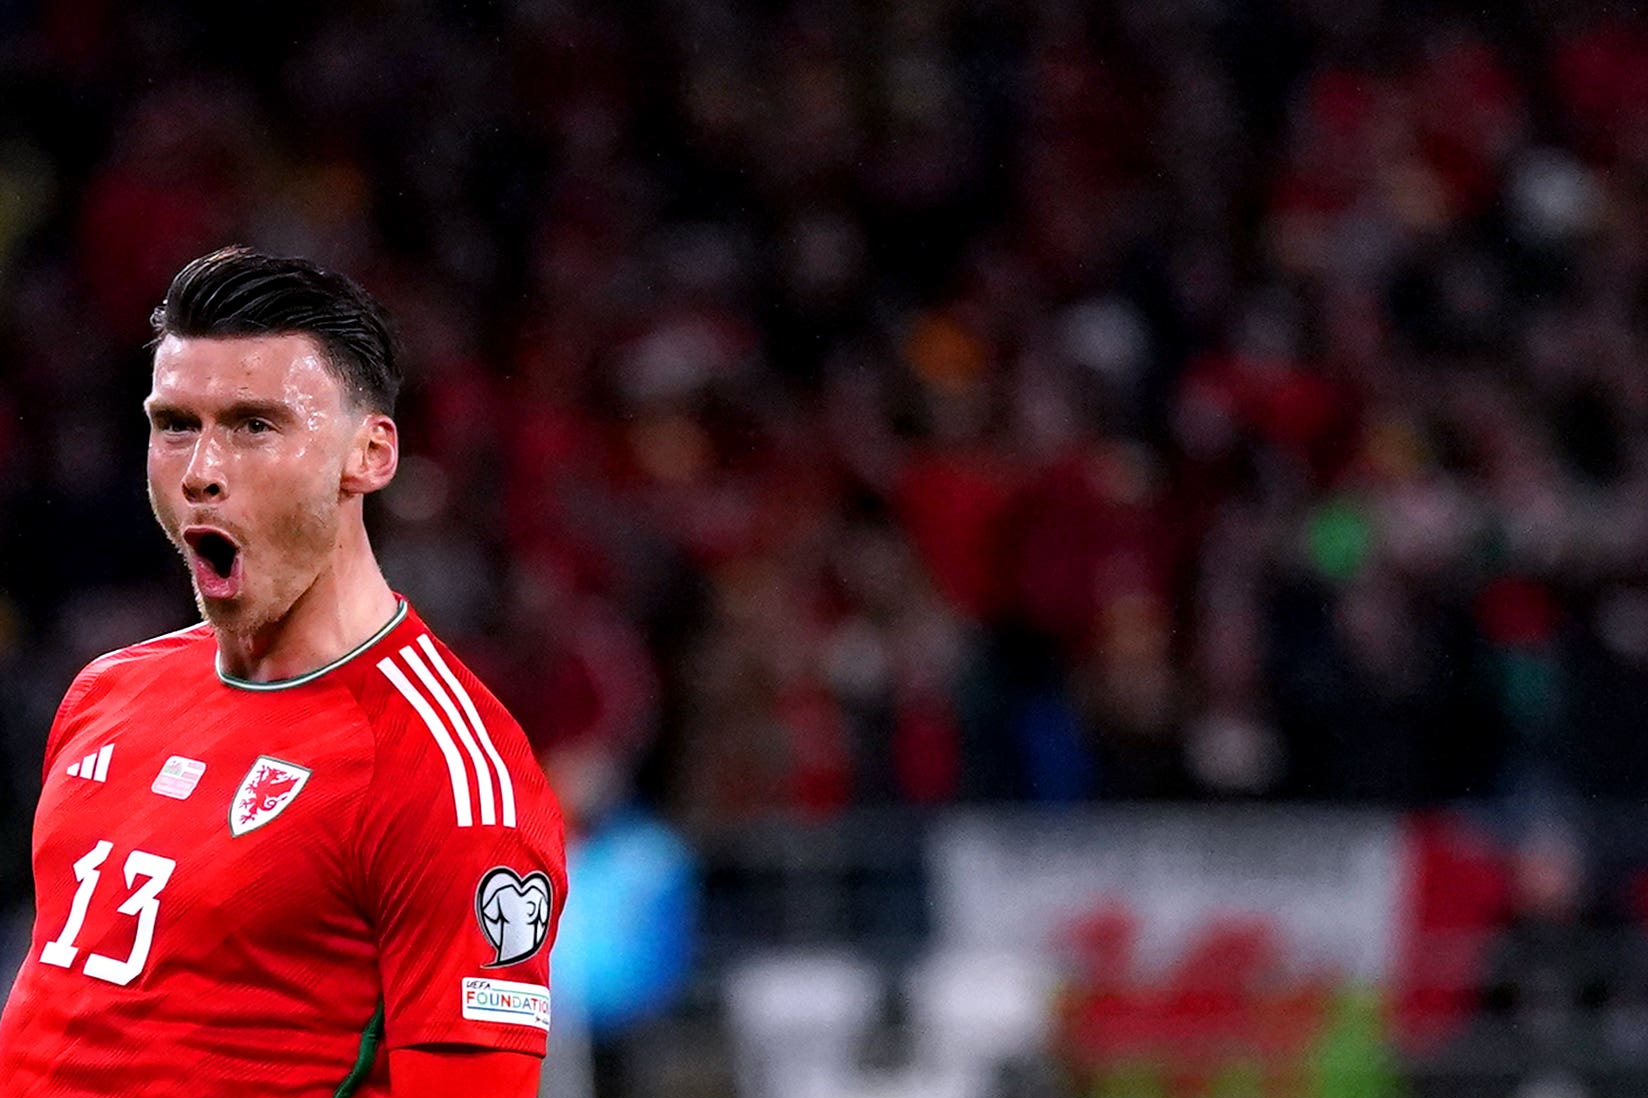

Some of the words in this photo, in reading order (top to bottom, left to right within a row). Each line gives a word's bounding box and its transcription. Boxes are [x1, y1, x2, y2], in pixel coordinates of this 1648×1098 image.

[39, 839, 176, 986] 13
[466, 980, 491, 990] UEFA
[466, 991, 549, 1014] FOUNDATIO
